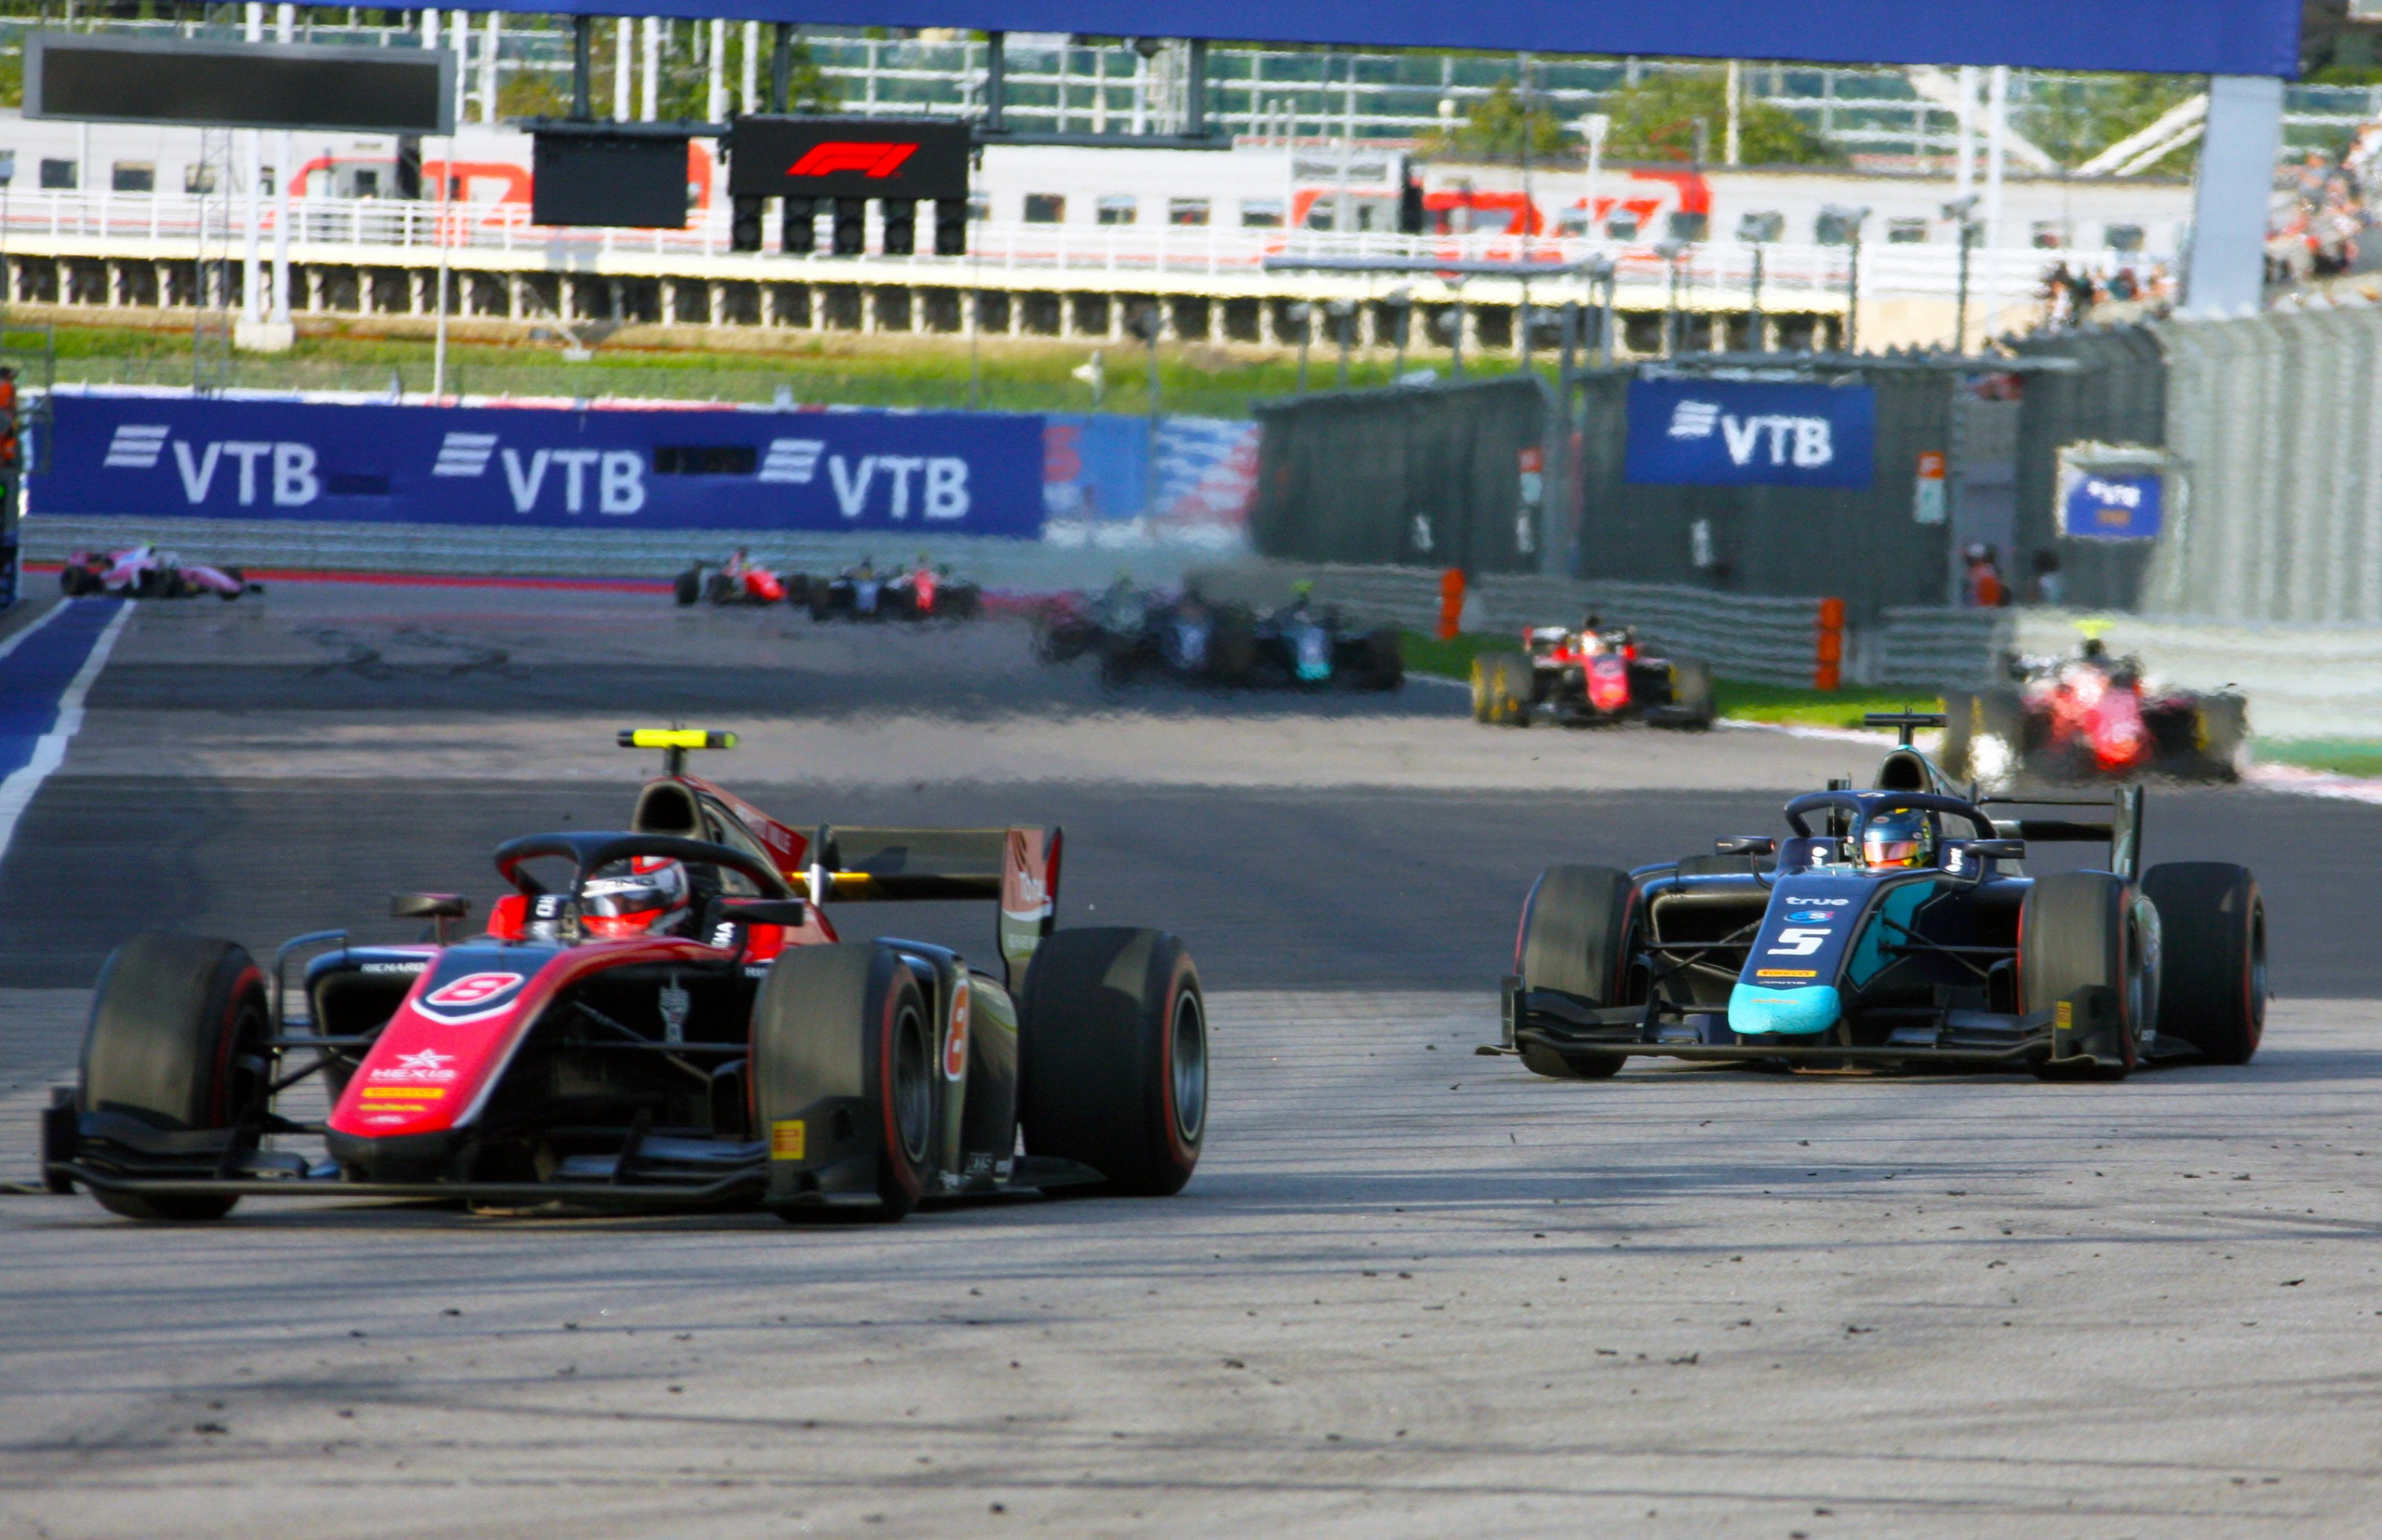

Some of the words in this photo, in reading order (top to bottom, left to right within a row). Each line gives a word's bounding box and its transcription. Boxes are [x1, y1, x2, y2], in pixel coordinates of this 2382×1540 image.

[785, 141, 920, 179] F1
[1720, 415, 1832, 468] VTB
[172, 440, 319, 506] VTB
[502, 449, 646, 514] VTB
[828, 454, 970, 518] VTB
[1786, 896, 1849, 906] true
[1767, 928, 1832, 956] 5
[425, 971, 525, 1007] 8
[943, 977, 970, 1082] 8
[369, 1069, 457, 1079] HEXIS
